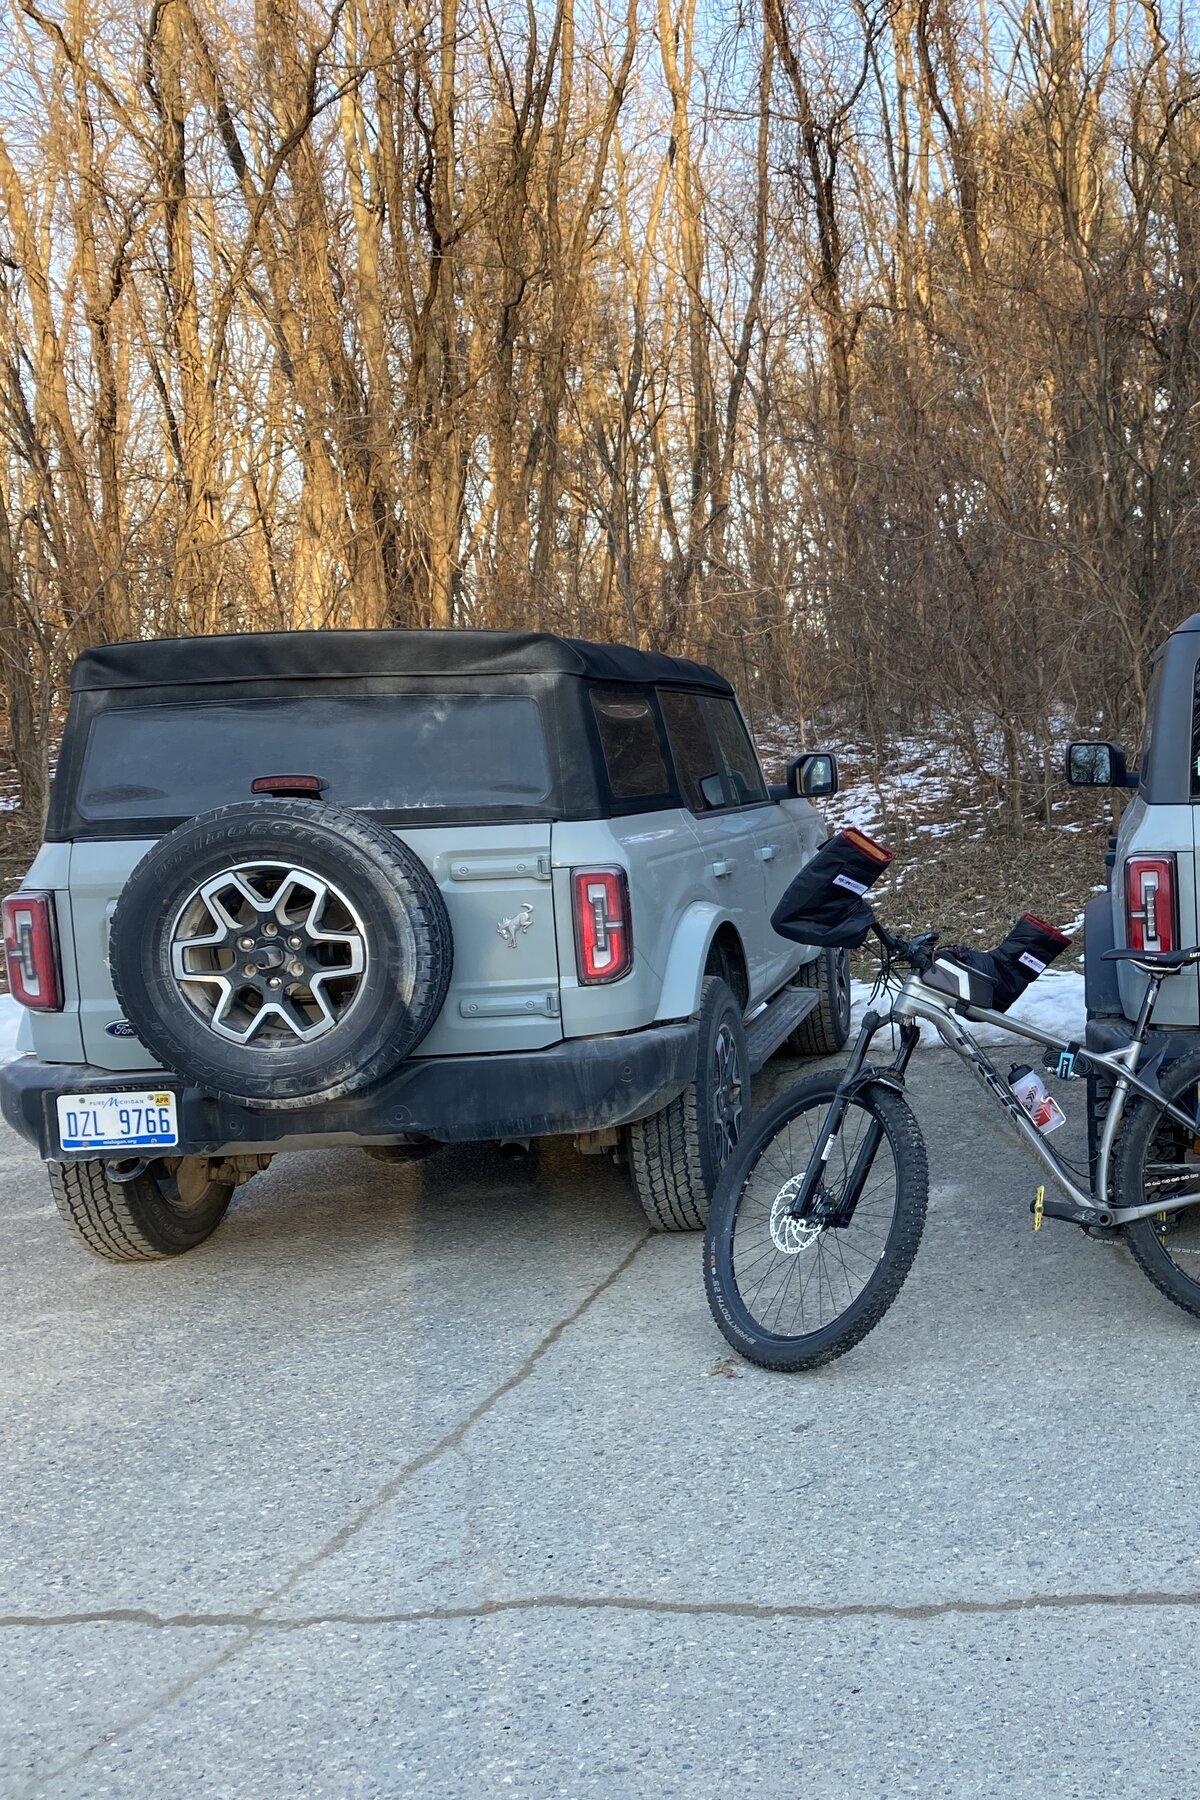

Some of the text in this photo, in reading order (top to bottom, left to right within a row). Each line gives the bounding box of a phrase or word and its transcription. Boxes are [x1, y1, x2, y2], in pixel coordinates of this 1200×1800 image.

[155, 1096, 169, 1104] APR
[66, 1107, 171, 1138] DZL 9766
[716, 1294, 757, 1345] SHARKTOOTH
